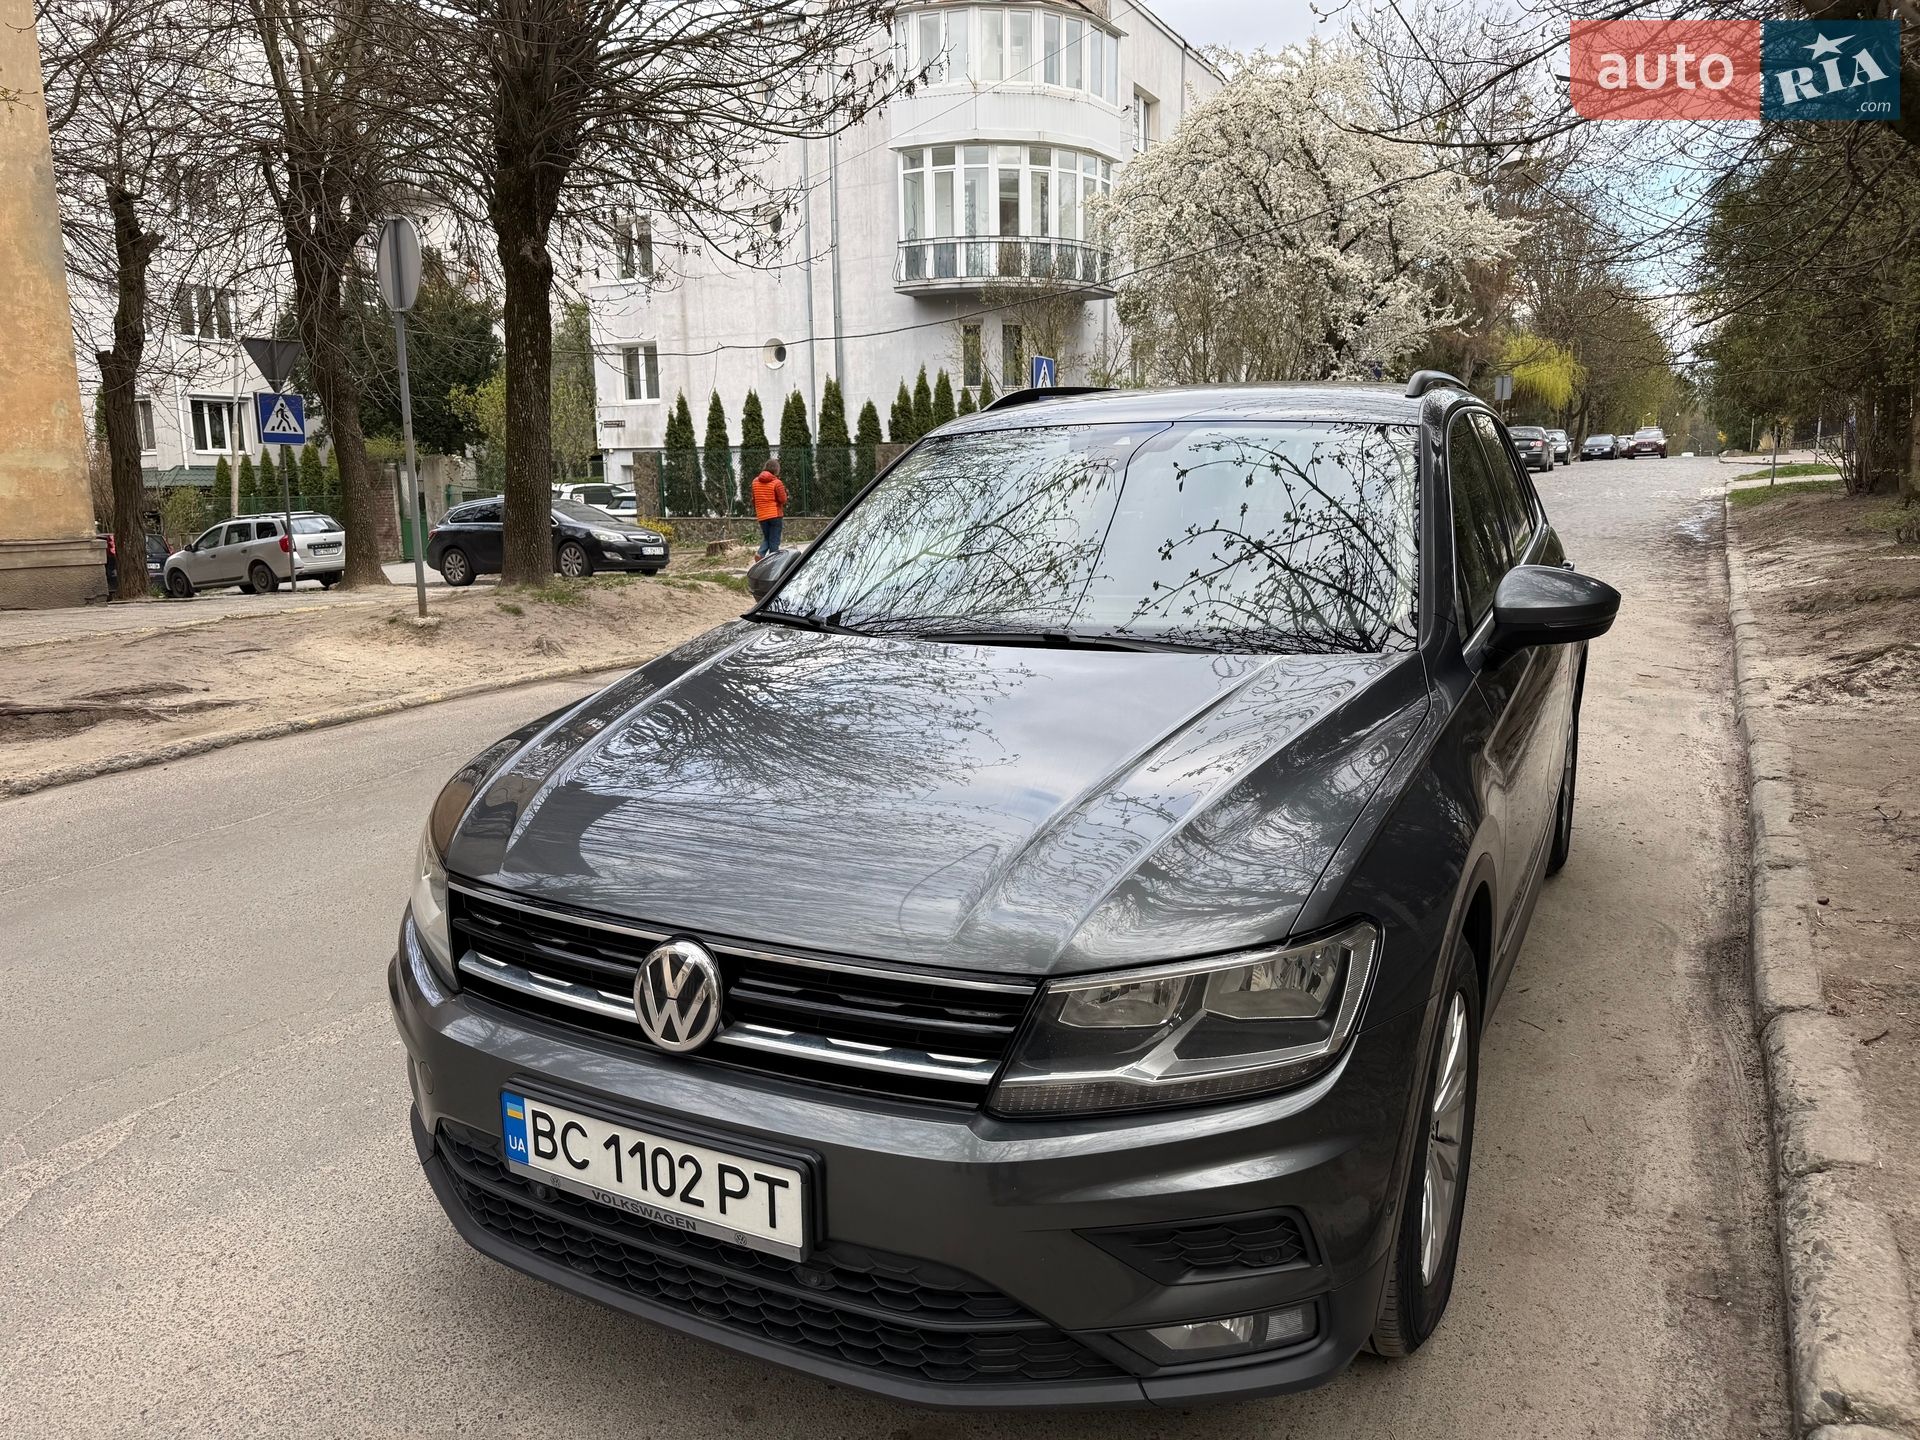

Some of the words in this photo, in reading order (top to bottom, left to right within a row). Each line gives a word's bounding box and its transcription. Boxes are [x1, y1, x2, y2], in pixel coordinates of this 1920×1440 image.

[508, 1134, 526, 1154] UA
[531, 1109, 590, 1170] BC
[603, 1134, 705, 1208] 1102
[718, 1163, 789, 1229] PT
[592, 1190, 698, 1232] VOLKSWAGEN
